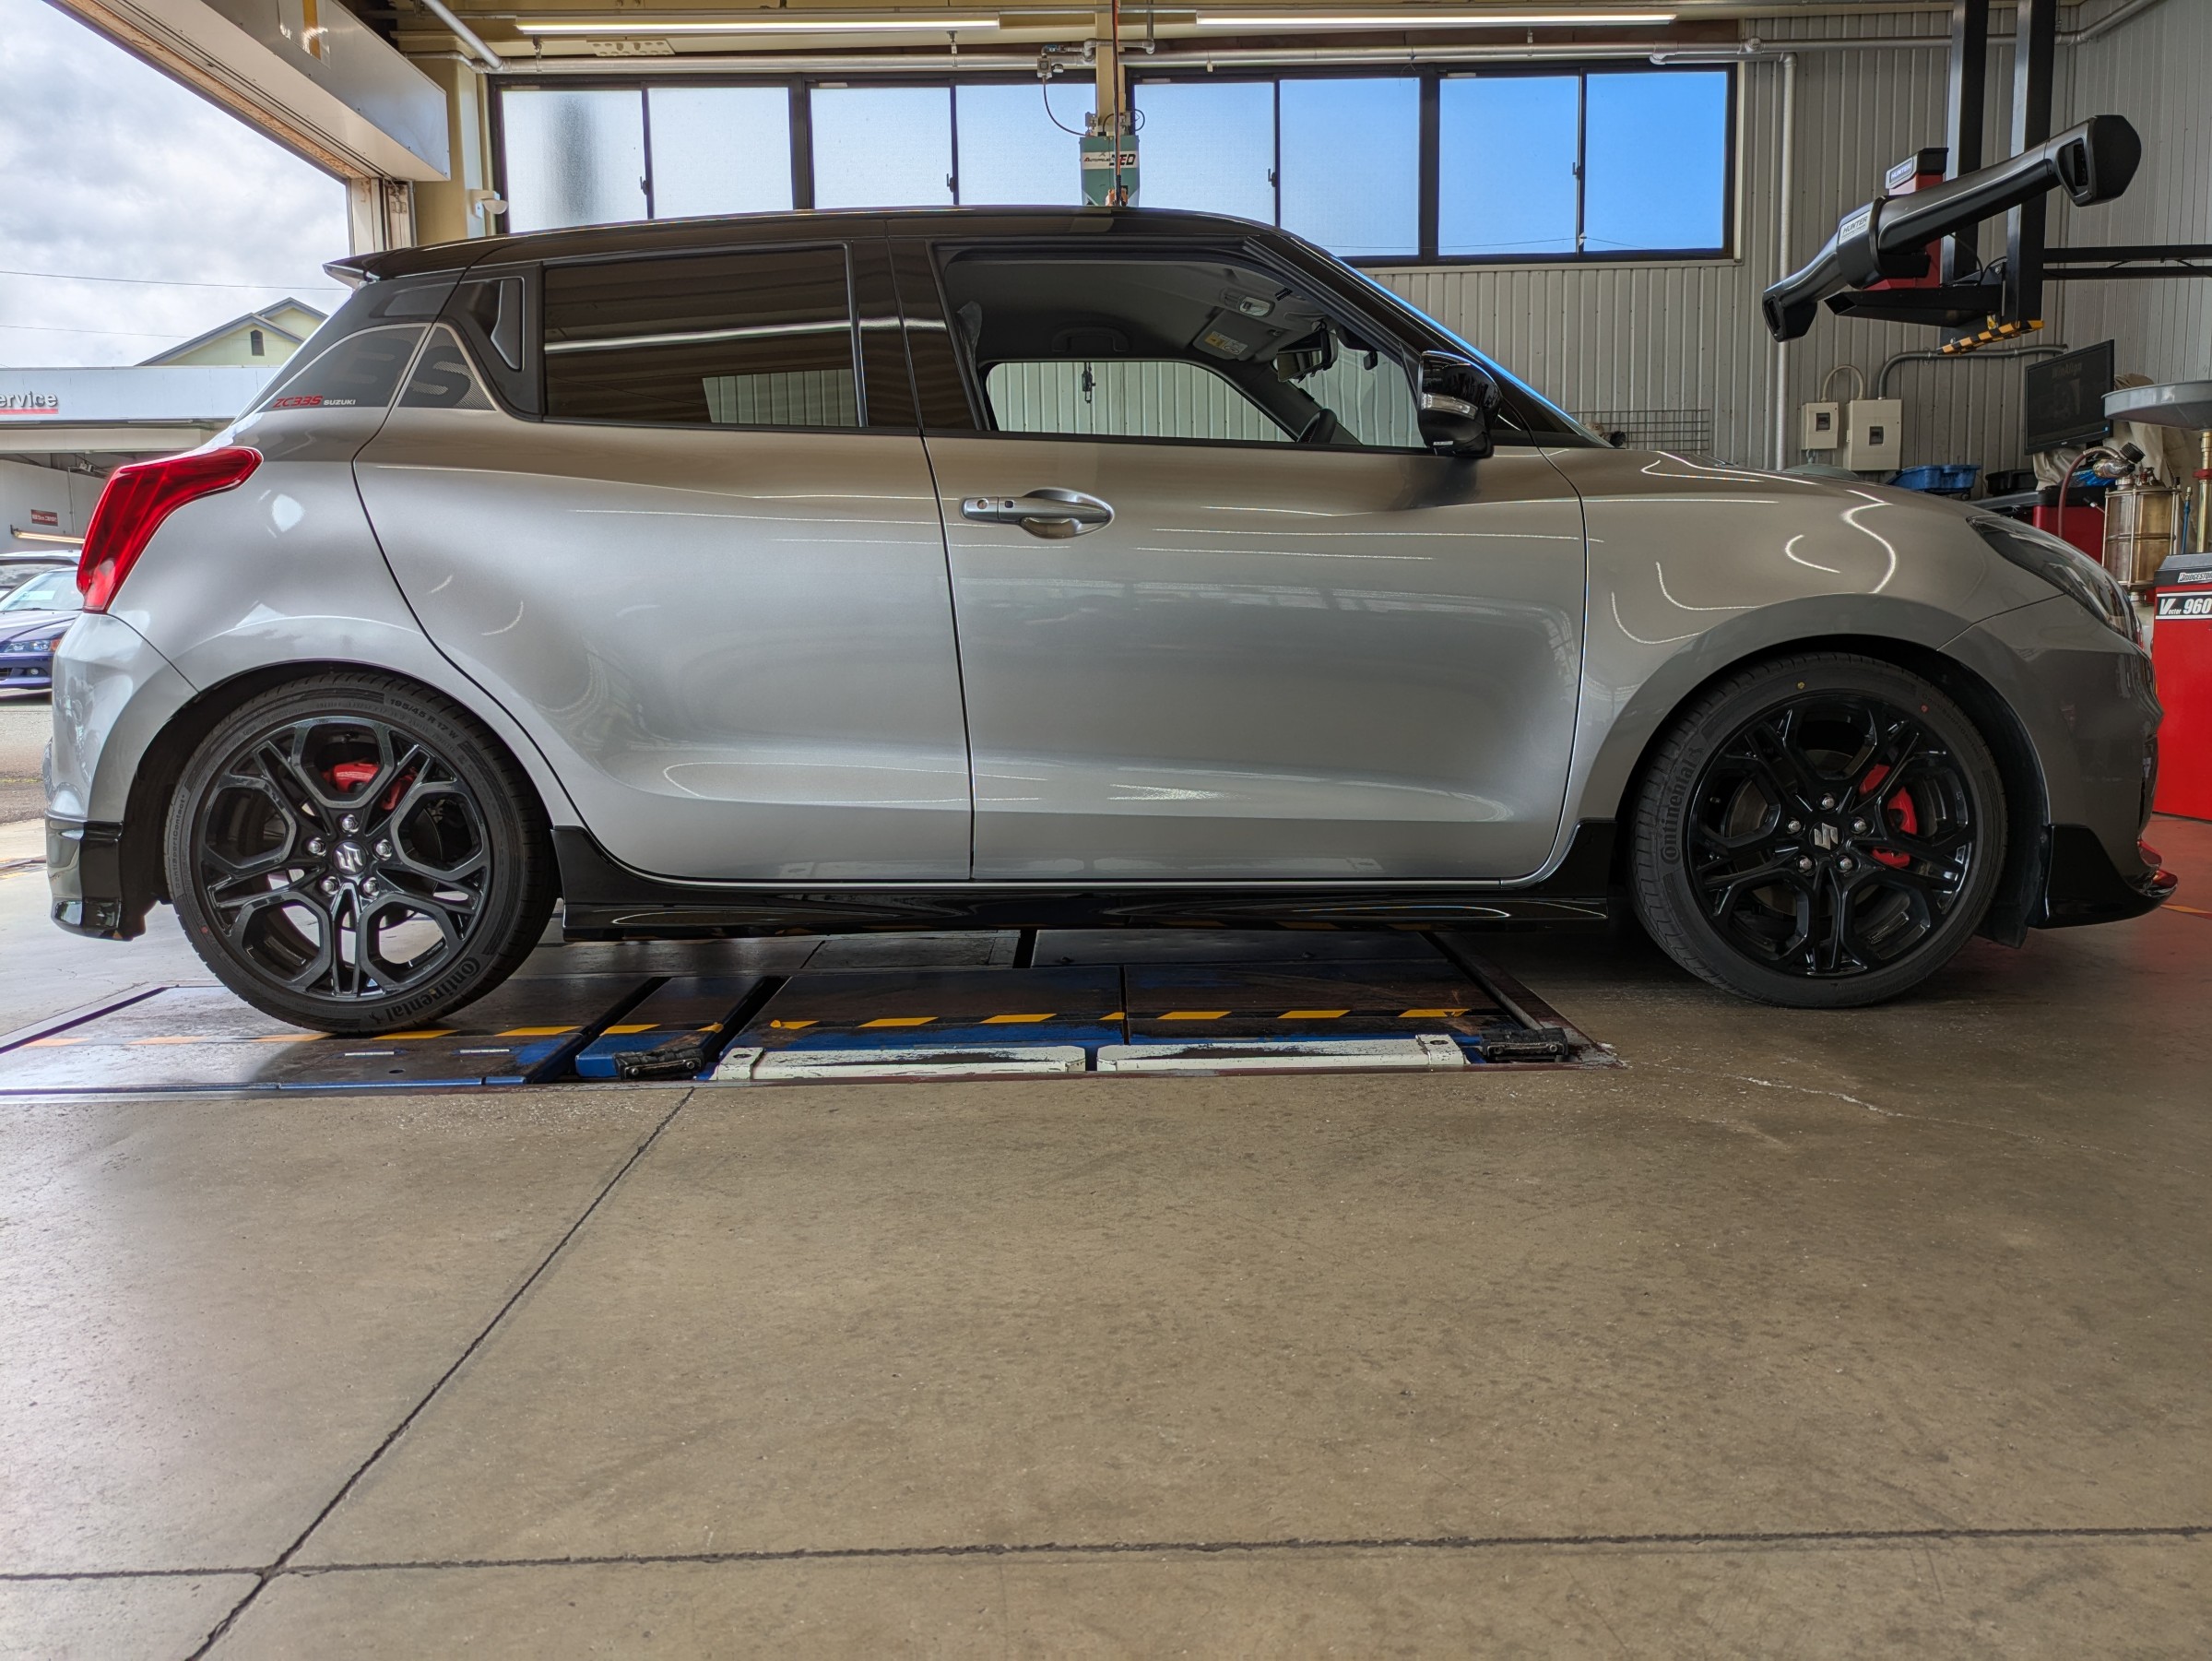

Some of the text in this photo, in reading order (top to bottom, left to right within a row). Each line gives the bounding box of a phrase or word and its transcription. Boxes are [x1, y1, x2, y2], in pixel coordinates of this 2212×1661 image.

[1891, 163, 1911, 178] HUNTER
[1843, 216, 1868, 233] HUNTER
[0, 391, 58, 407] ervice
[273, 396, 324, 408] ZC33S
[2159, 598, 2212, 614] Vector 960
[390, 699, 426, 718] 195/45
[427, 715, 435, 723] R
[436, 720, 449, 730] 17
[449, 730, 458, 739] W
[1661, 758, 1698, 864] Continental
[387, 957, 480, 1022] Continental
